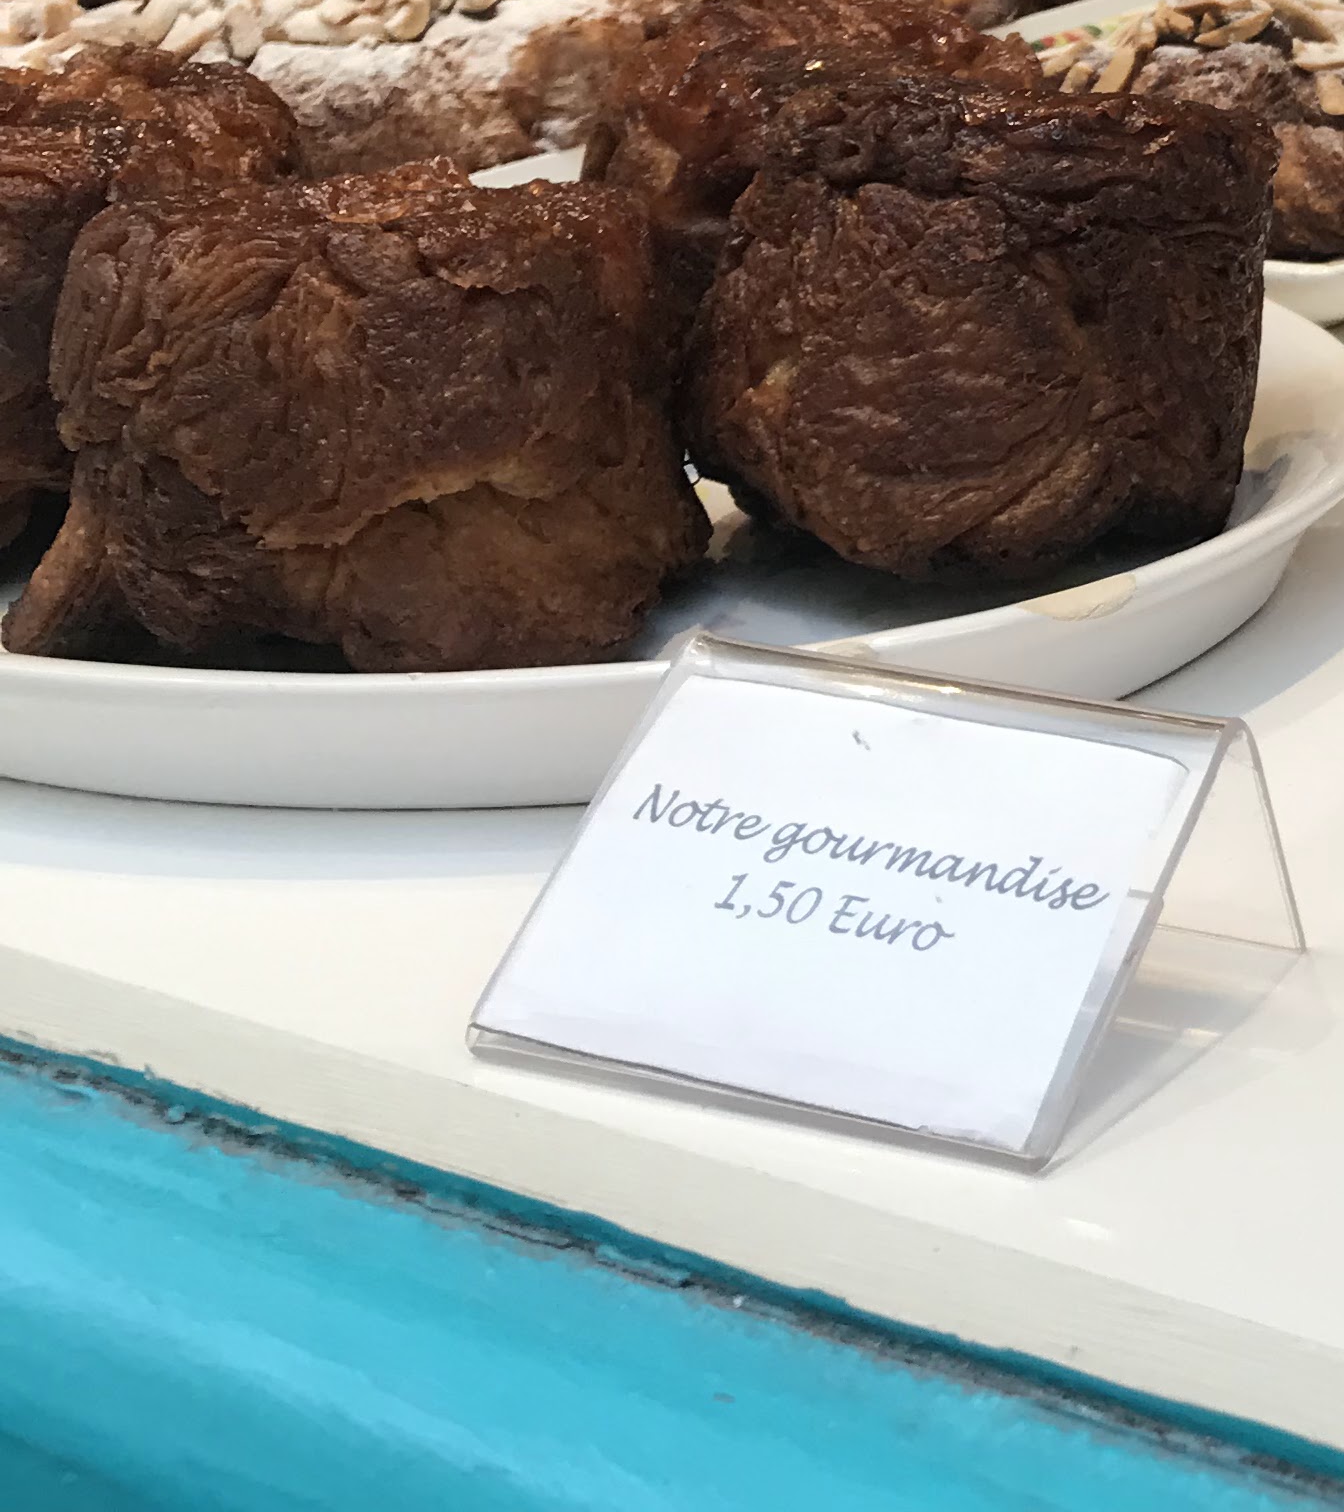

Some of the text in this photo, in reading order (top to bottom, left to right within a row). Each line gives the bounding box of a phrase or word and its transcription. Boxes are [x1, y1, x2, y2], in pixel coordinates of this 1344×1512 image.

[632, 782, 1110, 911] Notre gourmandise
[713, 872, 956, 952] 1,50 Euro
